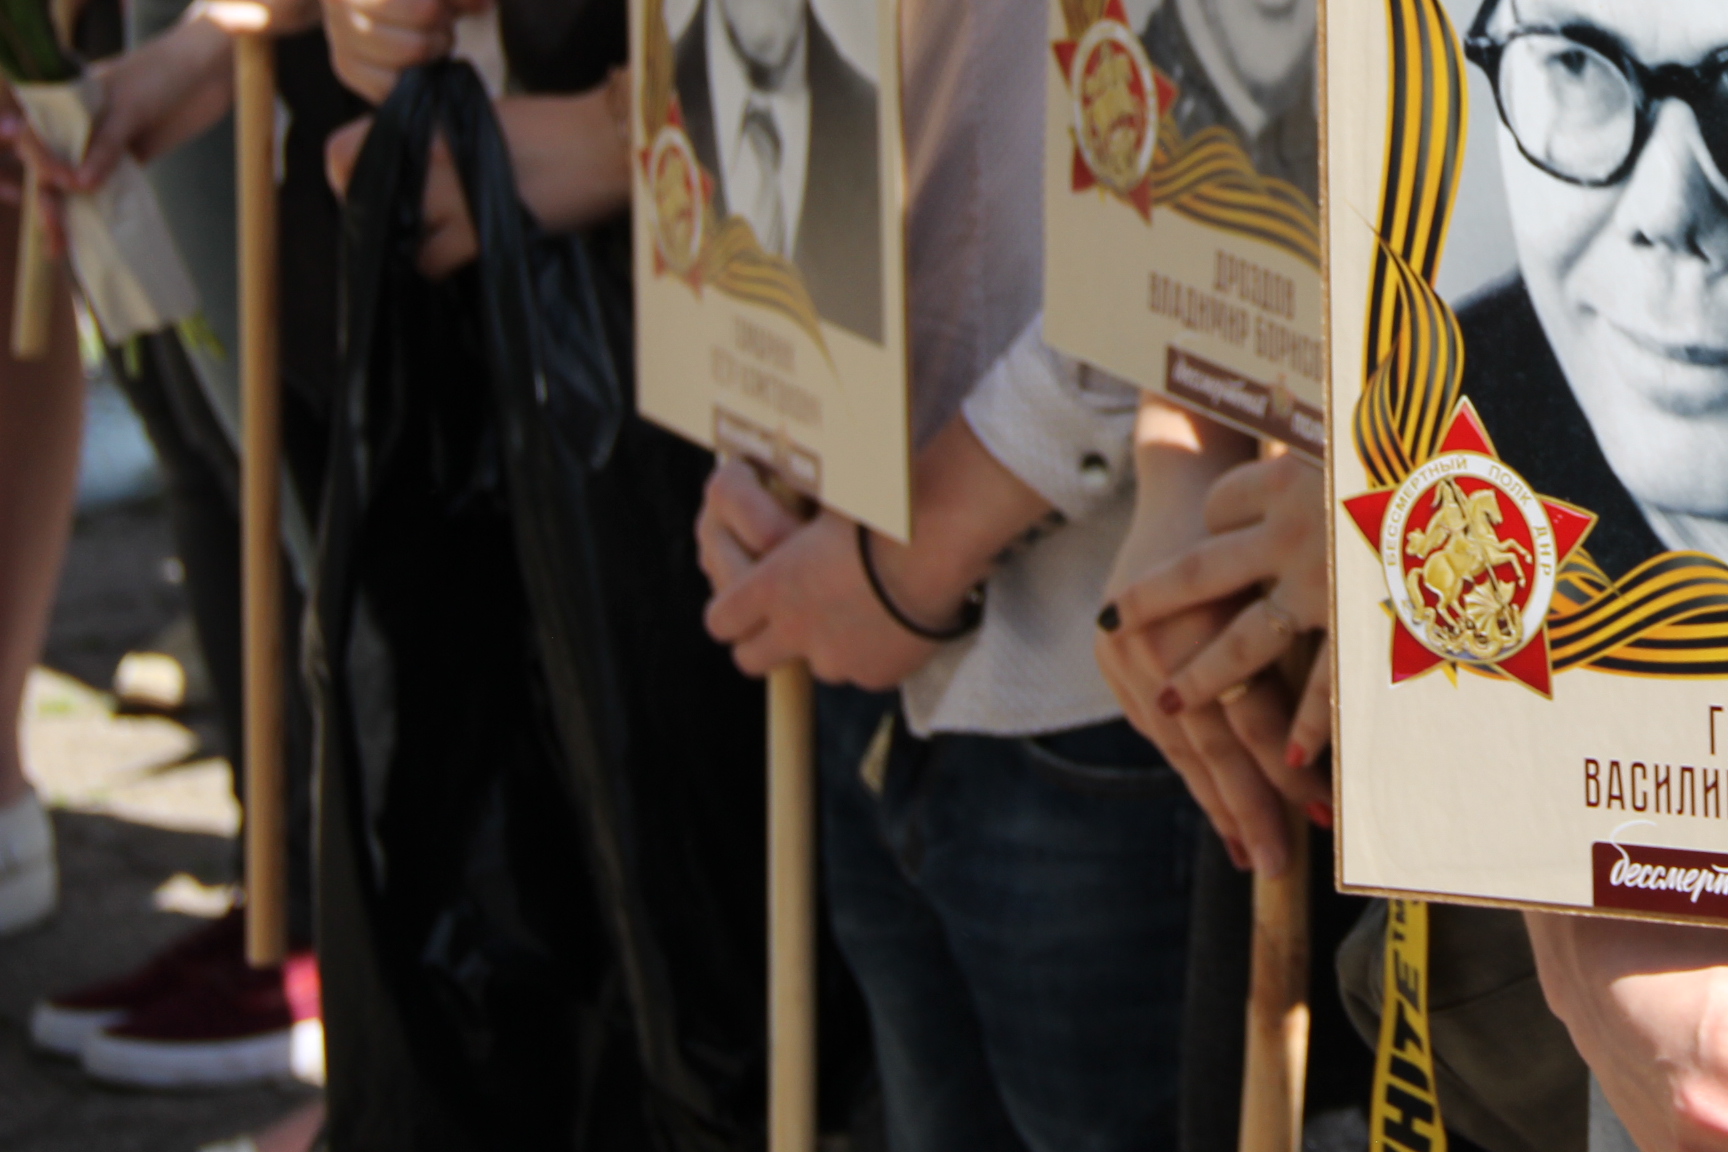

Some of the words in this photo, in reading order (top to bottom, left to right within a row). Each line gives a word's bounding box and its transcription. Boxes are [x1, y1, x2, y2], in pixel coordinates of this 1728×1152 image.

[1386, 456, 1468, 566] БЕССМЕРТНЫЙ
[1488, 464, 1532, 506] ПОЛК
[1533, 526, 1552, 576] ДНР
